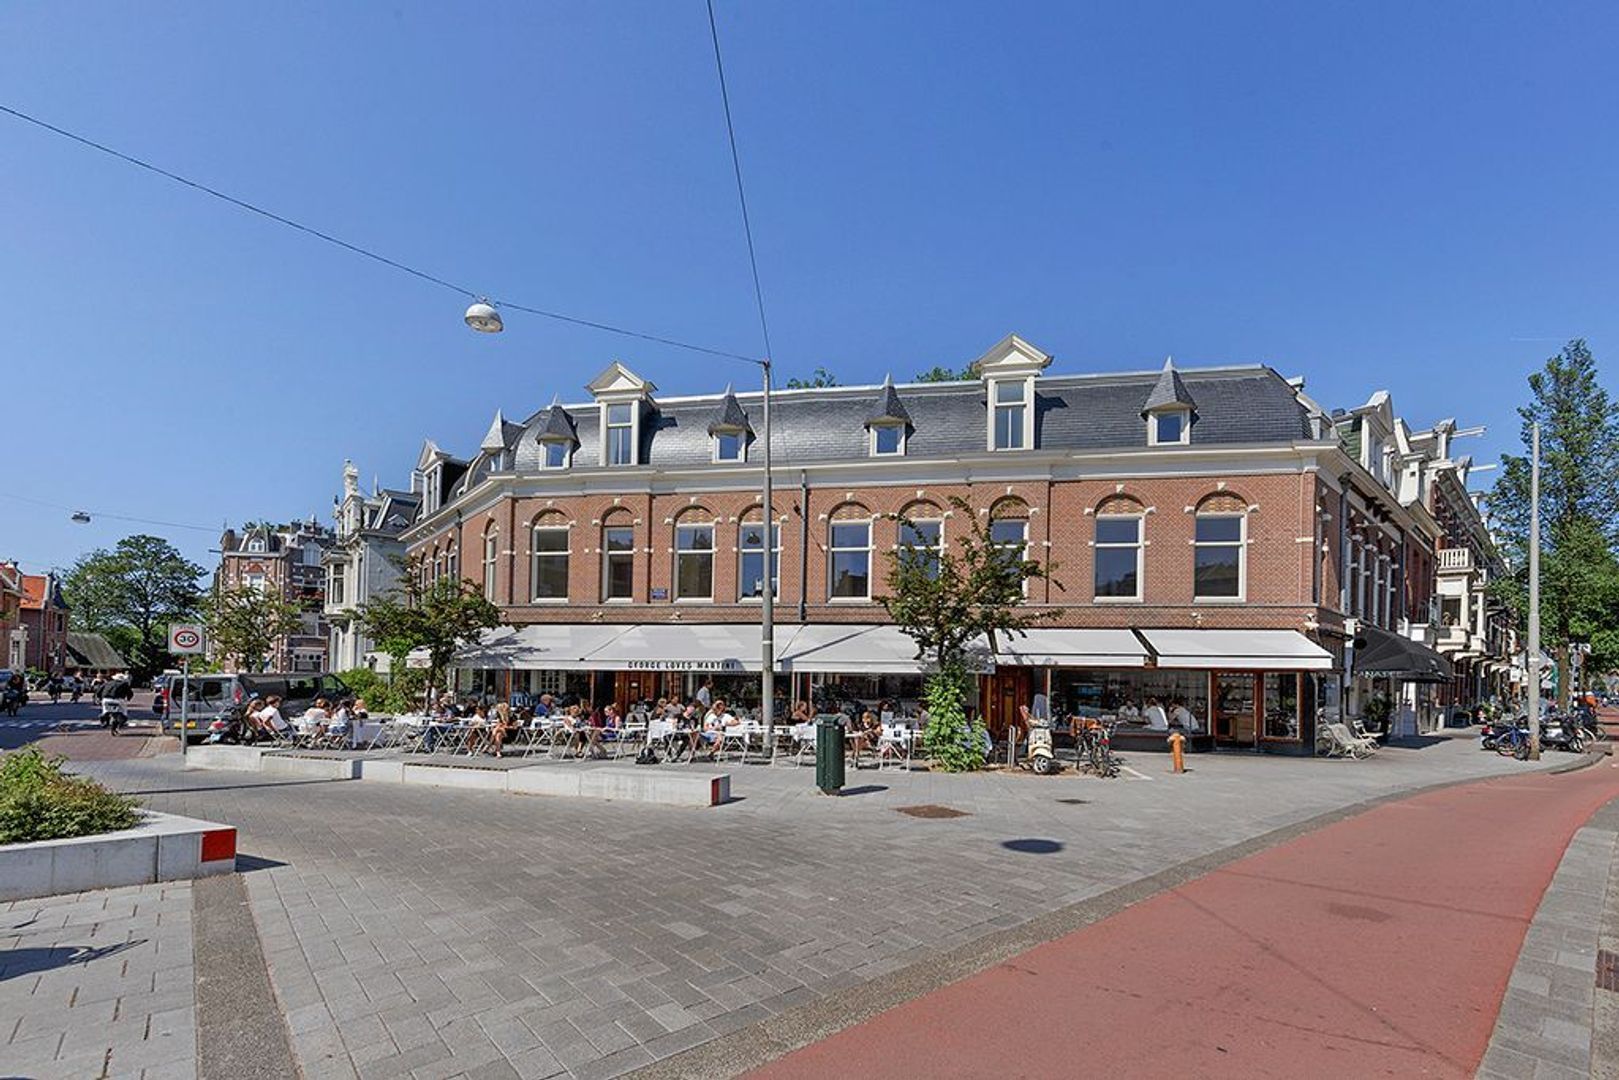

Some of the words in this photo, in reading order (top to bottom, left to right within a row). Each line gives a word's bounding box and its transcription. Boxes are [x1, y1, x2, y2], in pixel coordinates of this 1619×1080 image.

[179, 635, 195, 643] 30
[628, 661, 660, 669] GEORGE
[665, 661, 692, 669] LOVES
